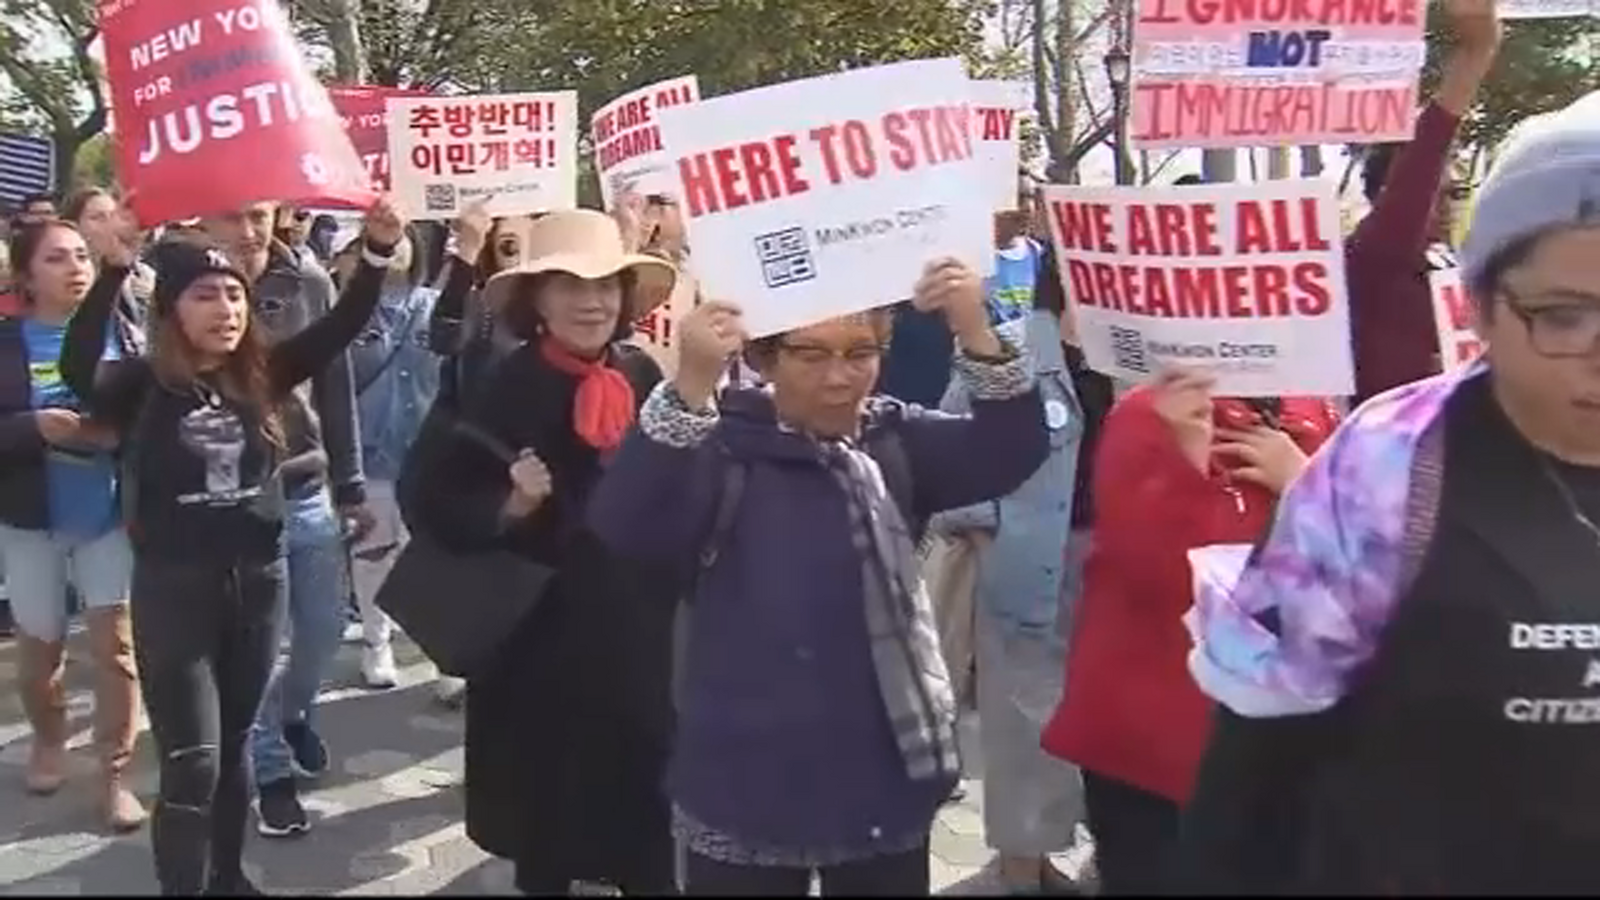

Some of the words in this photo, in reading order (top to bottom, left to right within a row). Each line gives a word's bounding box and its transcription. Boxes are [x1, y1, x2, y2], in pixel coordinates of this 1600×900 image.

[129, 20, 202, 71] NEW
[1247, 30, 1331, 68] NOT
[133, 76, 172, 107] FOR
[617, 95, 651, 132] ARE
[1130, 83, 1412, 140] IMMIGRATION
[408, 101, 555, 138] 추방반대!
[410, 139, 556, 176] 이민개혁!
[678, 134, 810, 218] HERE
[809, 119, 876, 185] TO
[881, 103, 974, 171] STAY
[1052, 201, 1117, 253] WE
[1125, 203, 1222, 256] ARE
[1234, 198, 1330, 253] ALL
[1068, 258, 1332, 318] DREAMERS
